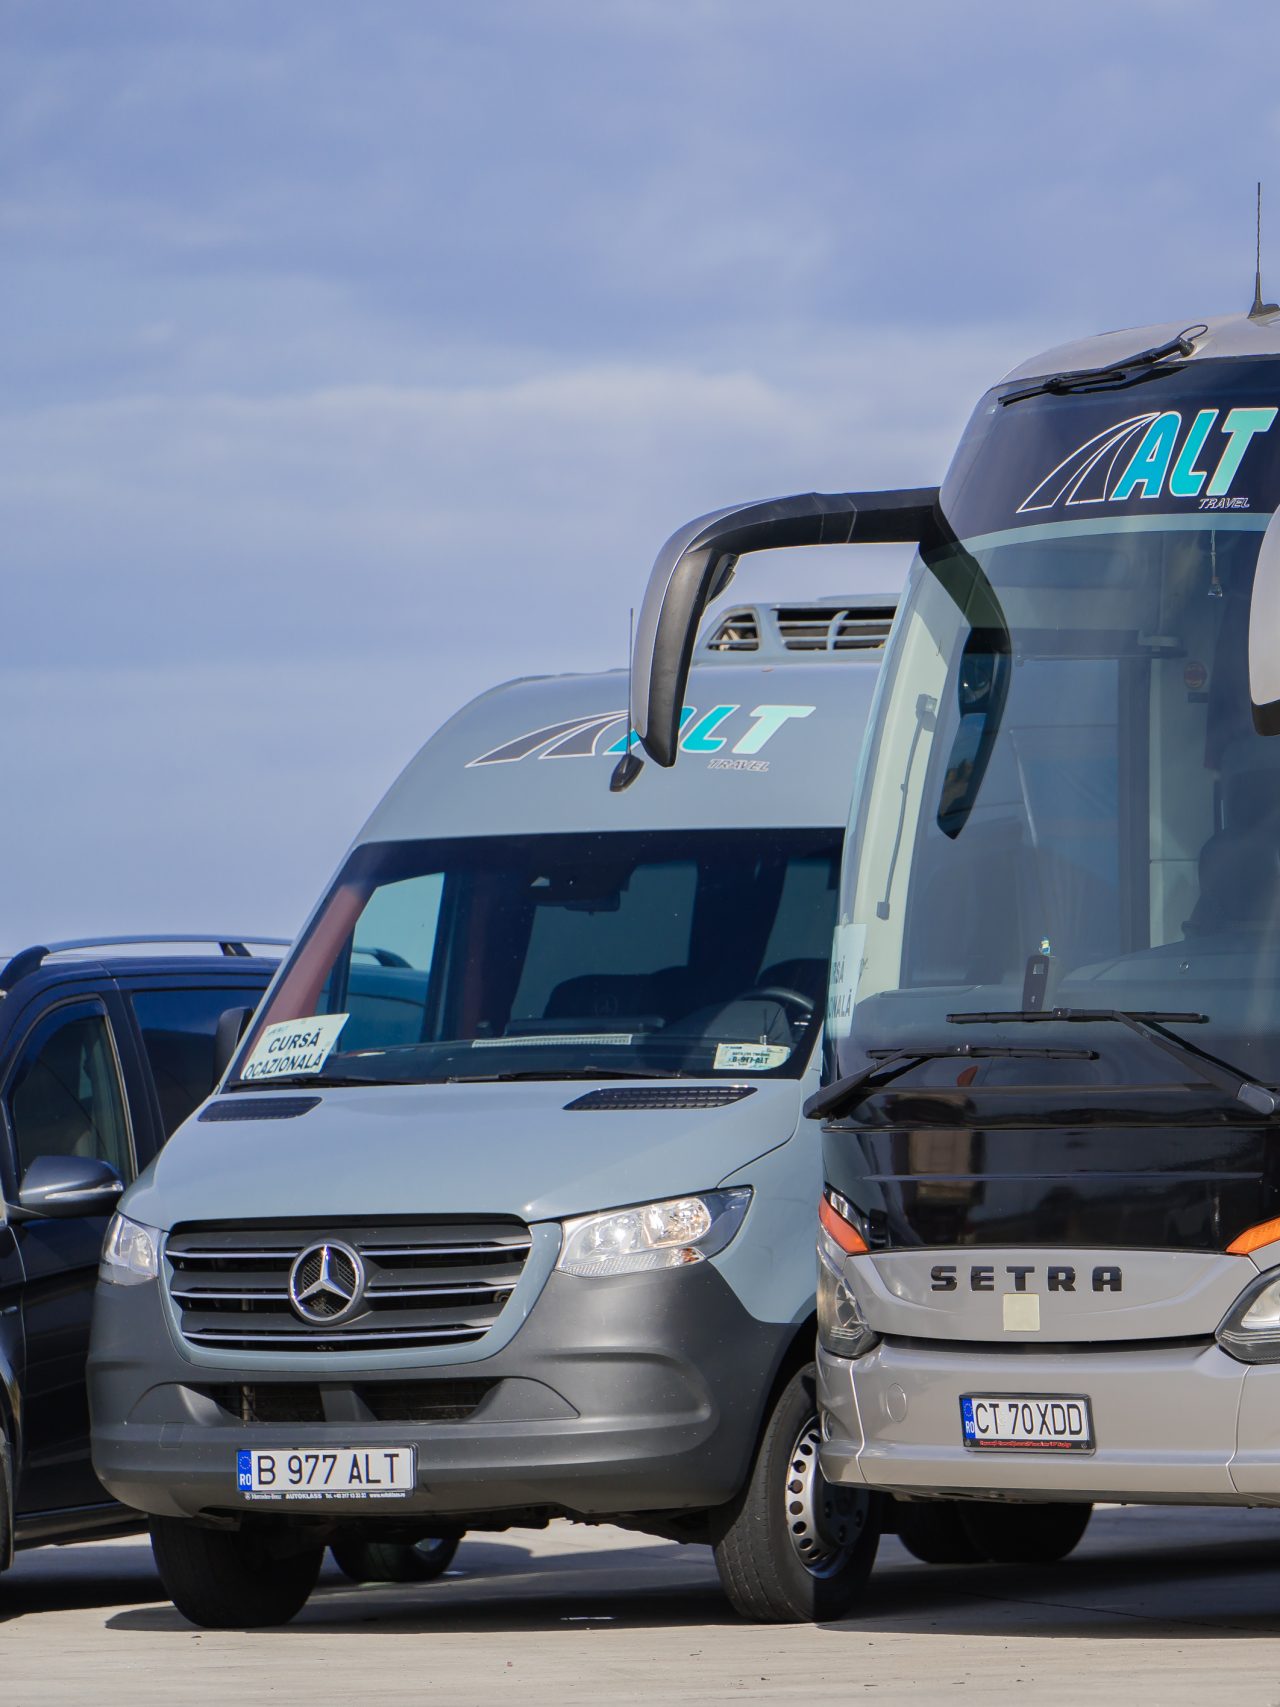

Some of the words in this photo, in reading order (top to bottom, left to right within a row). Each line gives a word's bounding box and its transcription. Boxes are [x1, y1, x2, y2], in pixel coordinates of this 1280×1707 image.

[1108, 407, 1280, 501] ALT
[1198, 496, 1250, 510] TRAVEL
[706, 758, 771, 773] TRAVEL
[267, 1027, 325, 1054] CURSĂ
[930, 1265, 1123, 1292] SETRA
[965, 1420, 975, 1434] RO
[975, 1402, 999, 1435] CT
[239, 1473, 251, 1486] RO
[257, 1455, 276, 1485] B
[288, 1454, 338, 1485] 977
[348, 1453, 400, 1485] ALT
